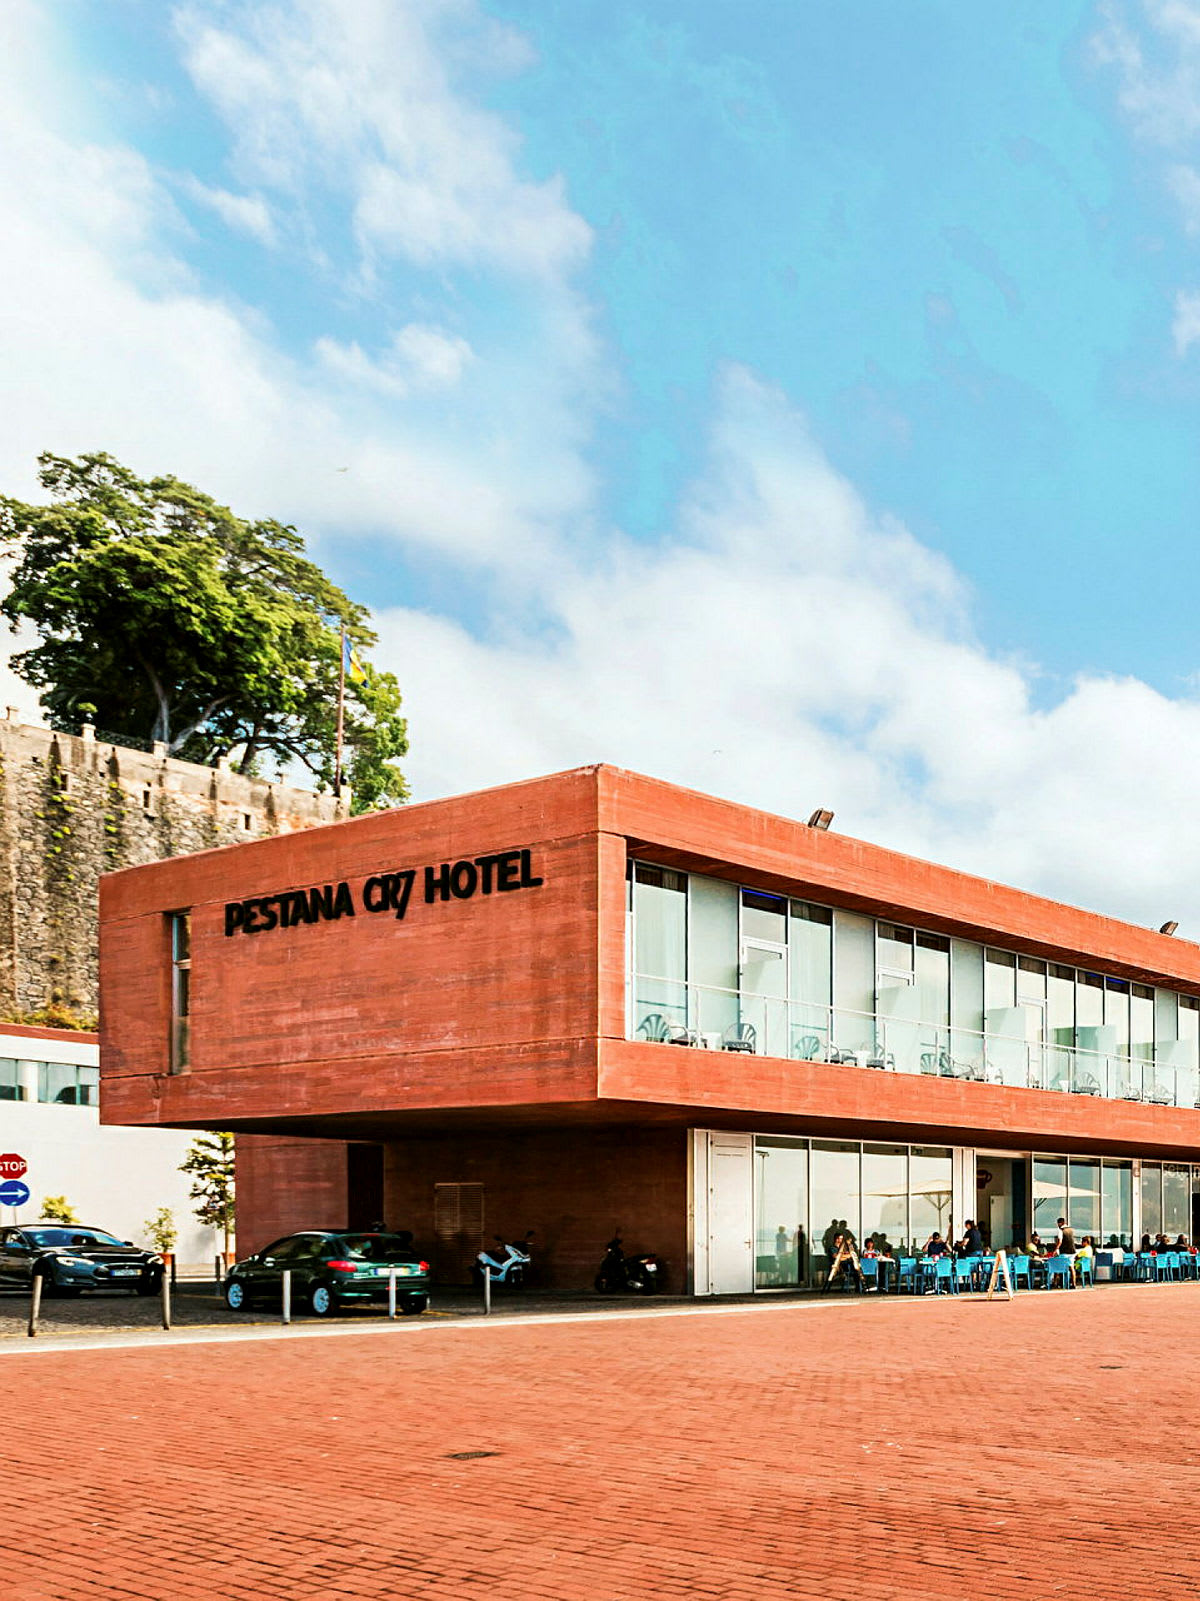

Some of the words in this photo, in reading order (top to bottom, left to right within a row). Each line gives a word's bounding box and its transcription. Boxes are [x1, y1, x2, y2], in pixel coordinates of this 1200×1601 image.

[225, 882, 355, 936] PESTANA
[363, 870, 416, 919] CR7
[425, 849, 543, 903] HOTEL
